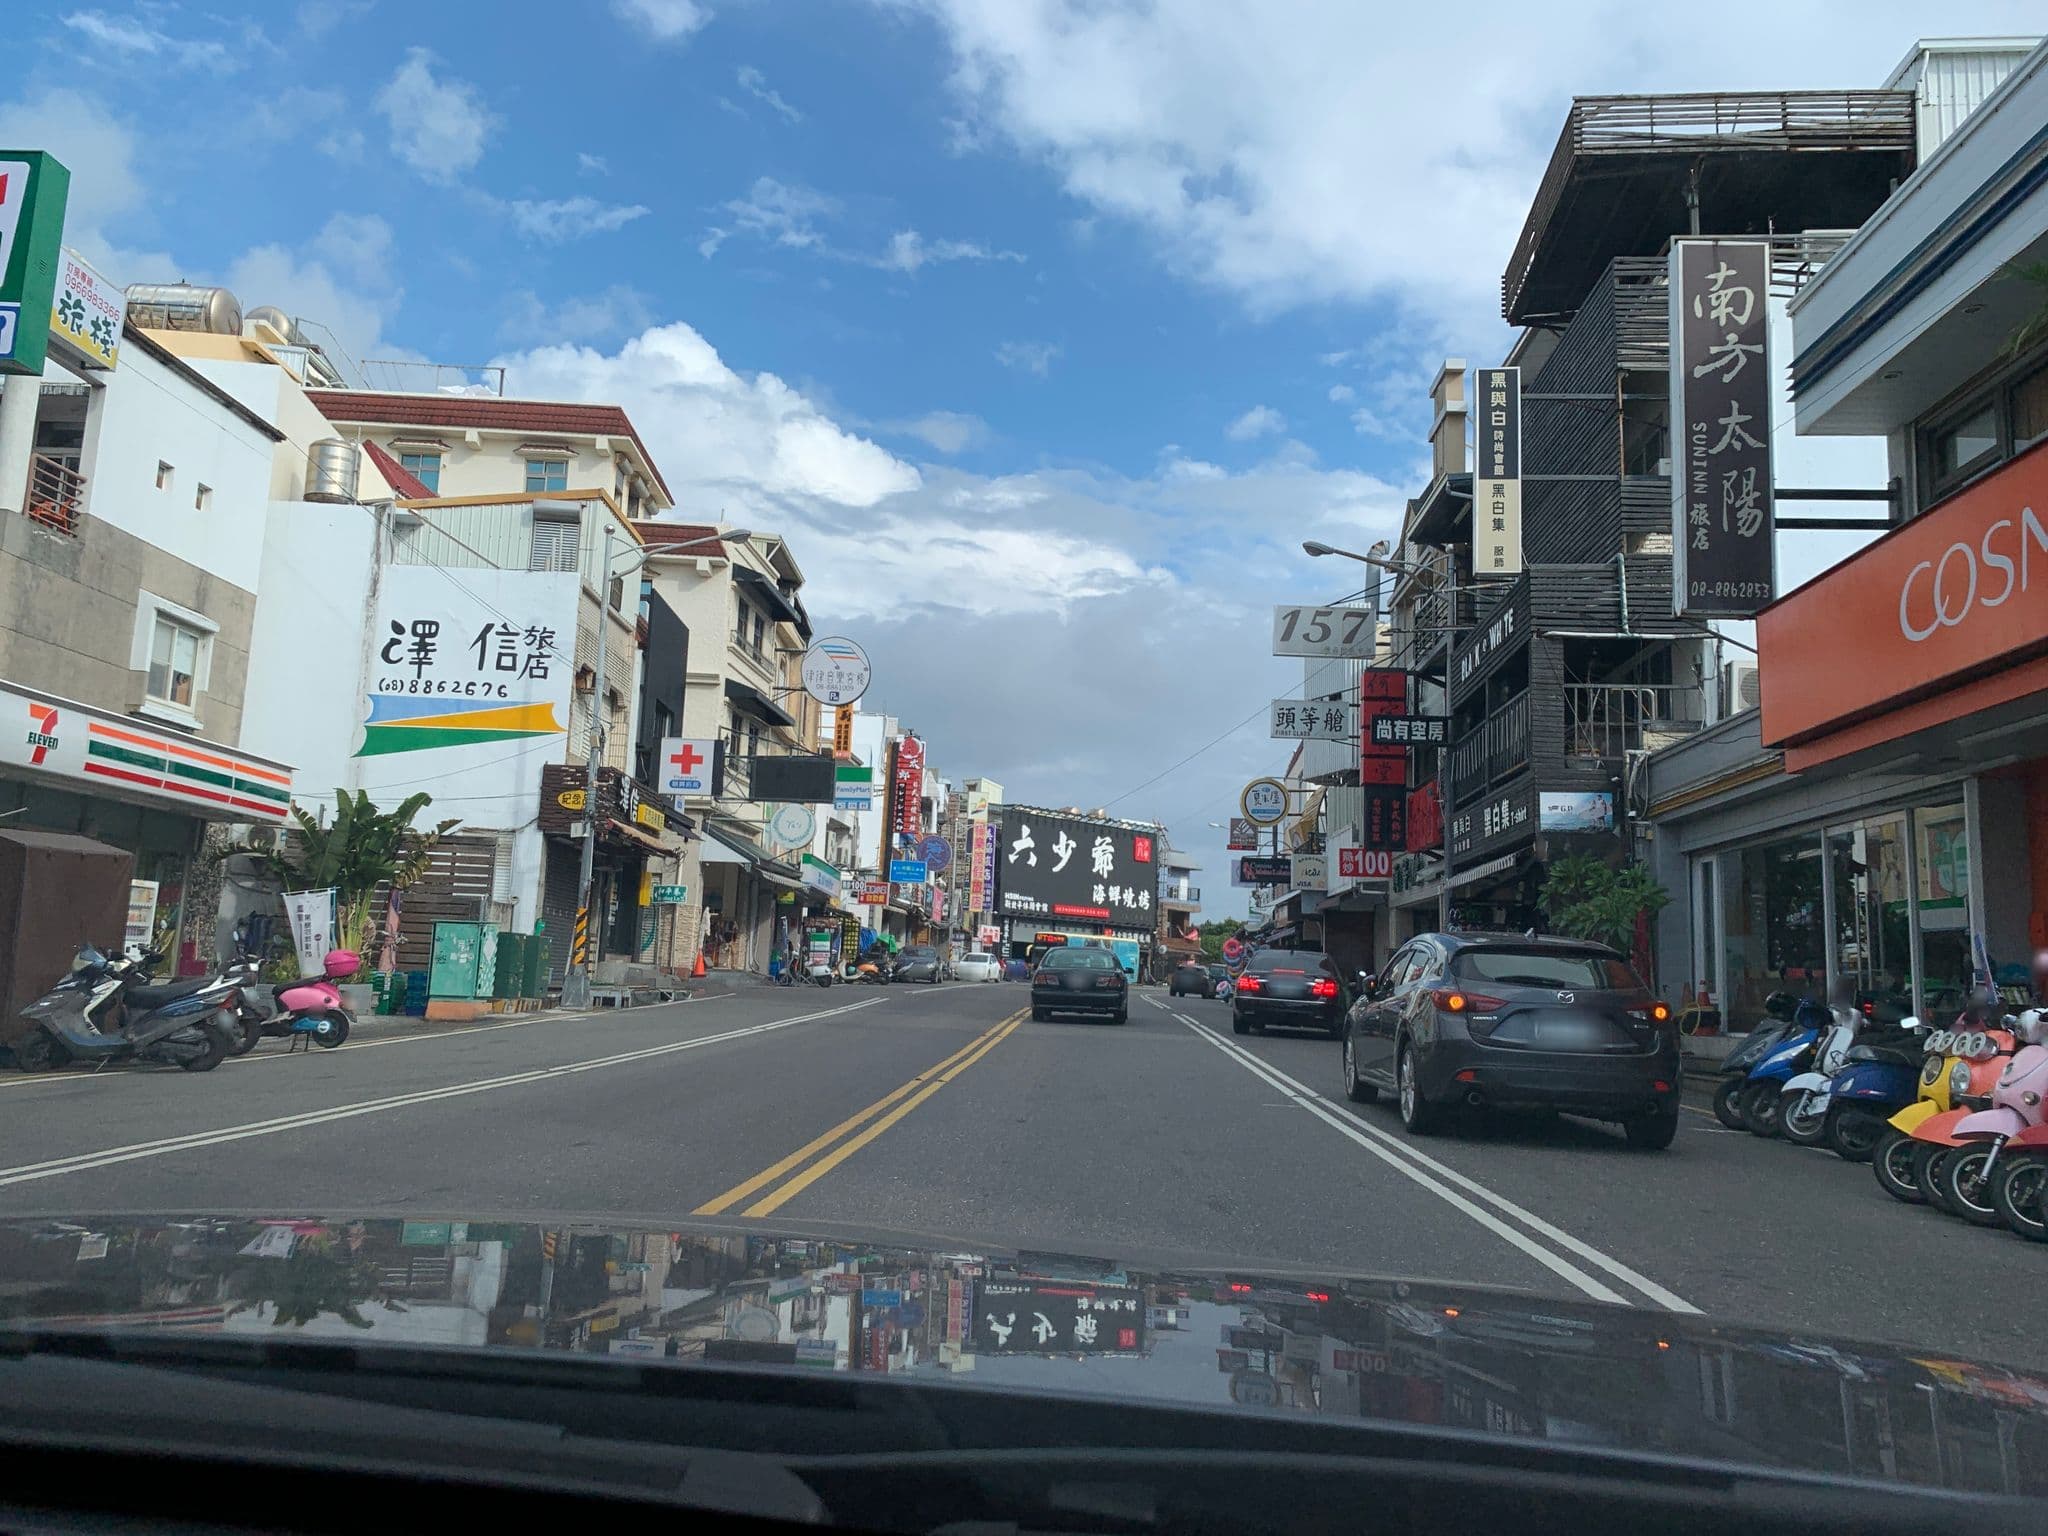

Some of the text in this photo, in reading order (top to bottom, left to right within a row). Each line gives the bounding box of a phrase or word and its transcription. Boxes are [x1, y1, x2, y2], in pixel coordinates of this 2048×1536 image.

[64, 273, 120, 322] 0966983366
[1693, 261, 1767, 538] 南方太陽
[1689, 502, 1712, 550] 旅店
[1279, 609, 1370, 645] 157
[29, 703, 58, 765] 7
[1275, 706, 1345, 733] 頭等艙
[1376, 719, 1444, 742] 尚有空房
[836, 786, 870, 794] FamilyMart
[1008, 824, 1116, 879] 六少爺
[1354, 851, 1389, 875] 100
[1092, 884, 1151, 911] 海鮮燒烤
